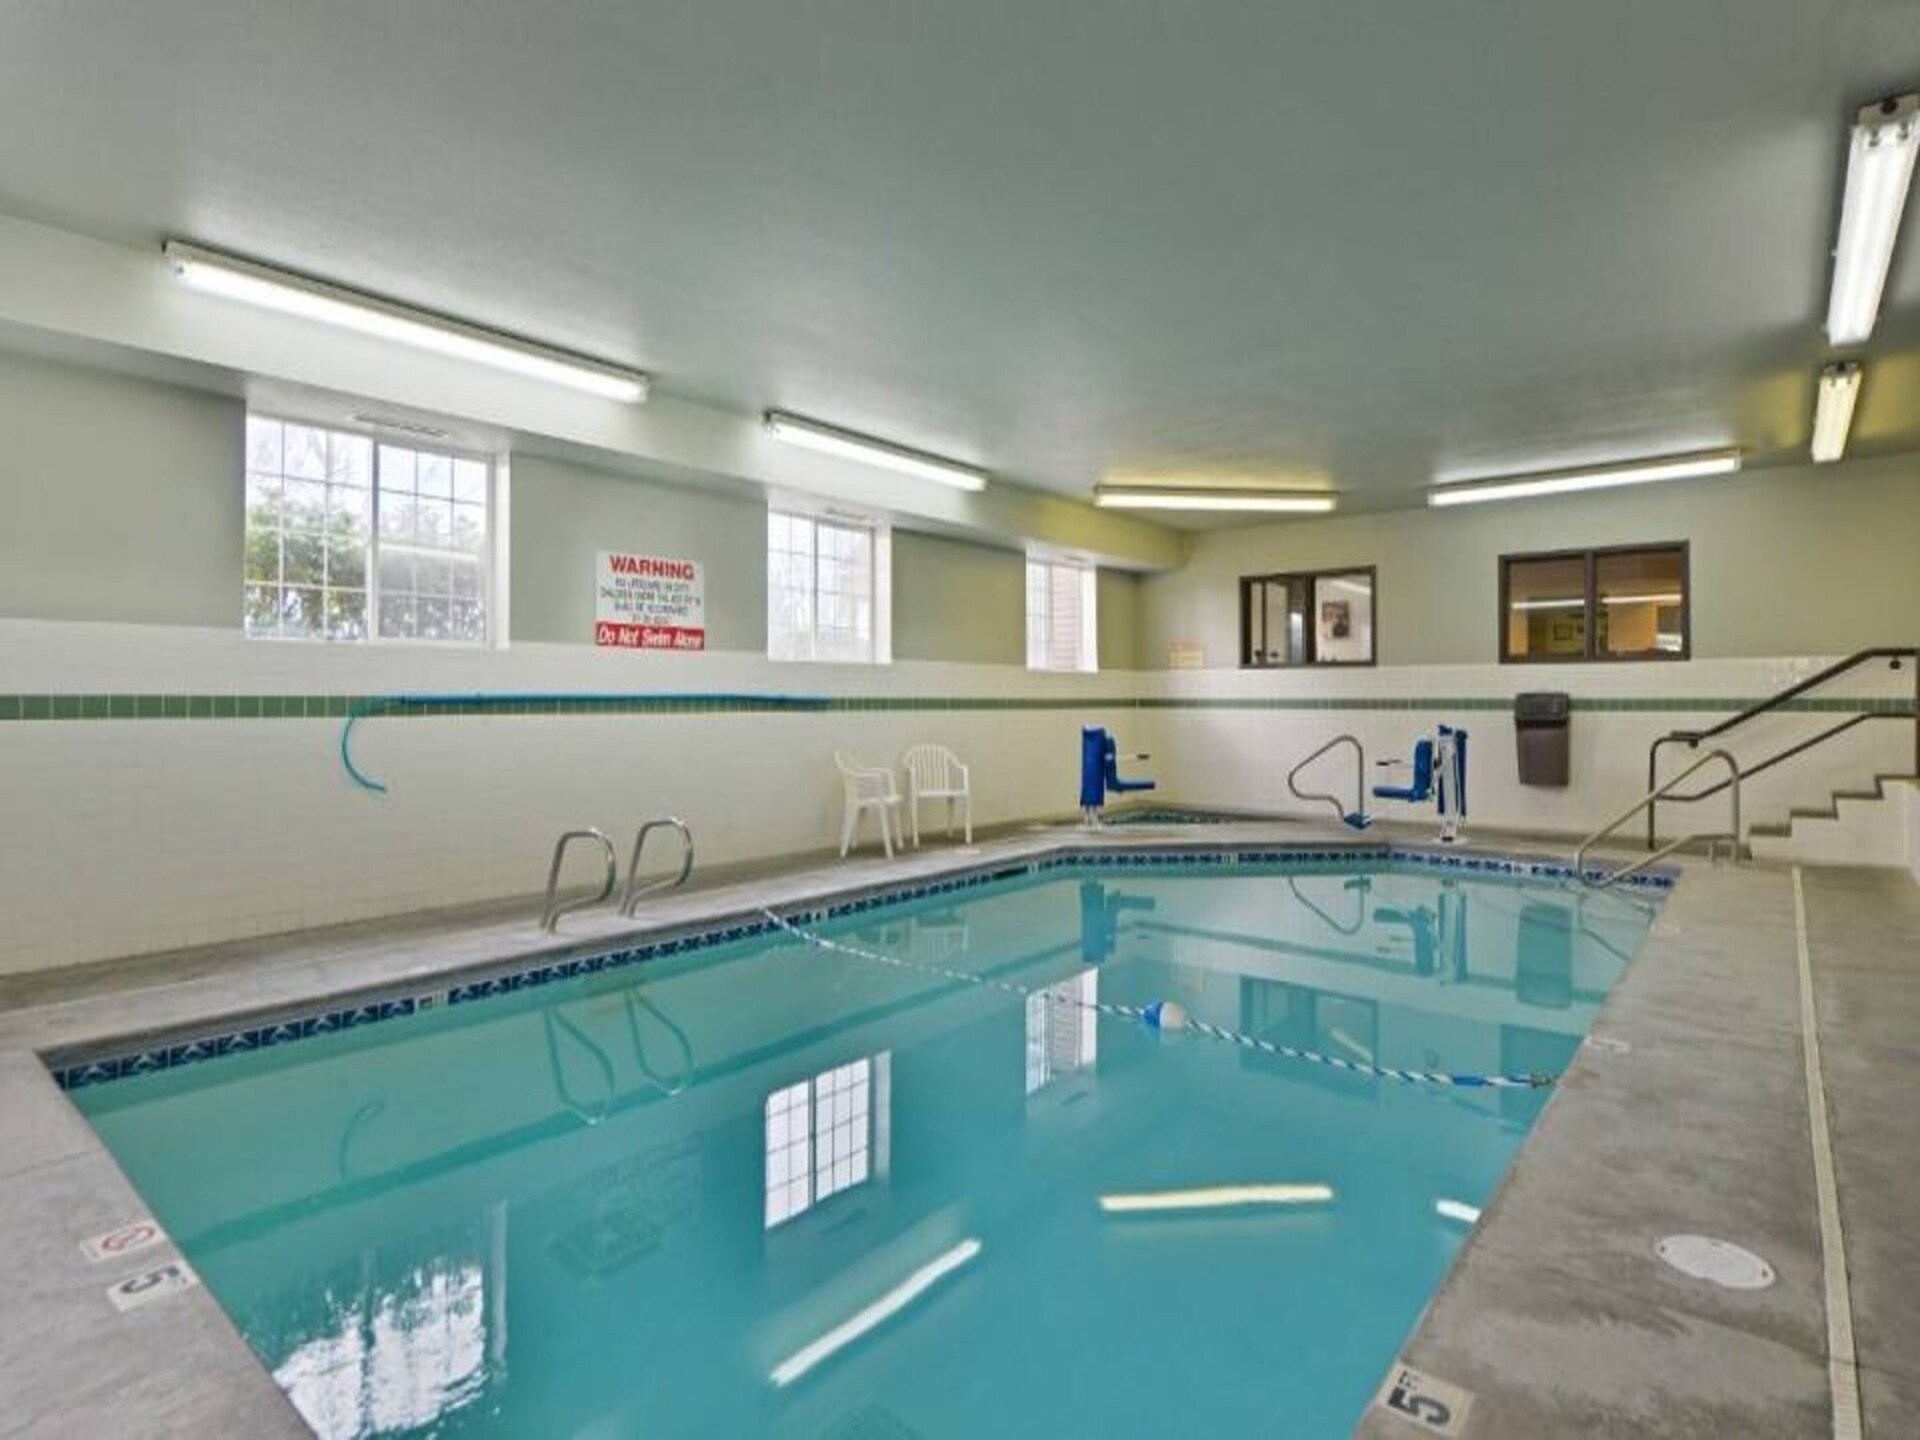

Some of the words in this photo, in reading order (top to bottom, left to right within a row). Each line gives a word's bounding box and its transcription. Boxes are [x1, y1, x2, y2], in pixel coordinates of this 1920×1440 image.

[609, 555, 695, 580] WARNING
[600, 624, 616, 643] Do
[618, 626, 638, 645] Not
[642, 628, 672, 647] Swim
[1387, 1386, 1450, 1425] 5
